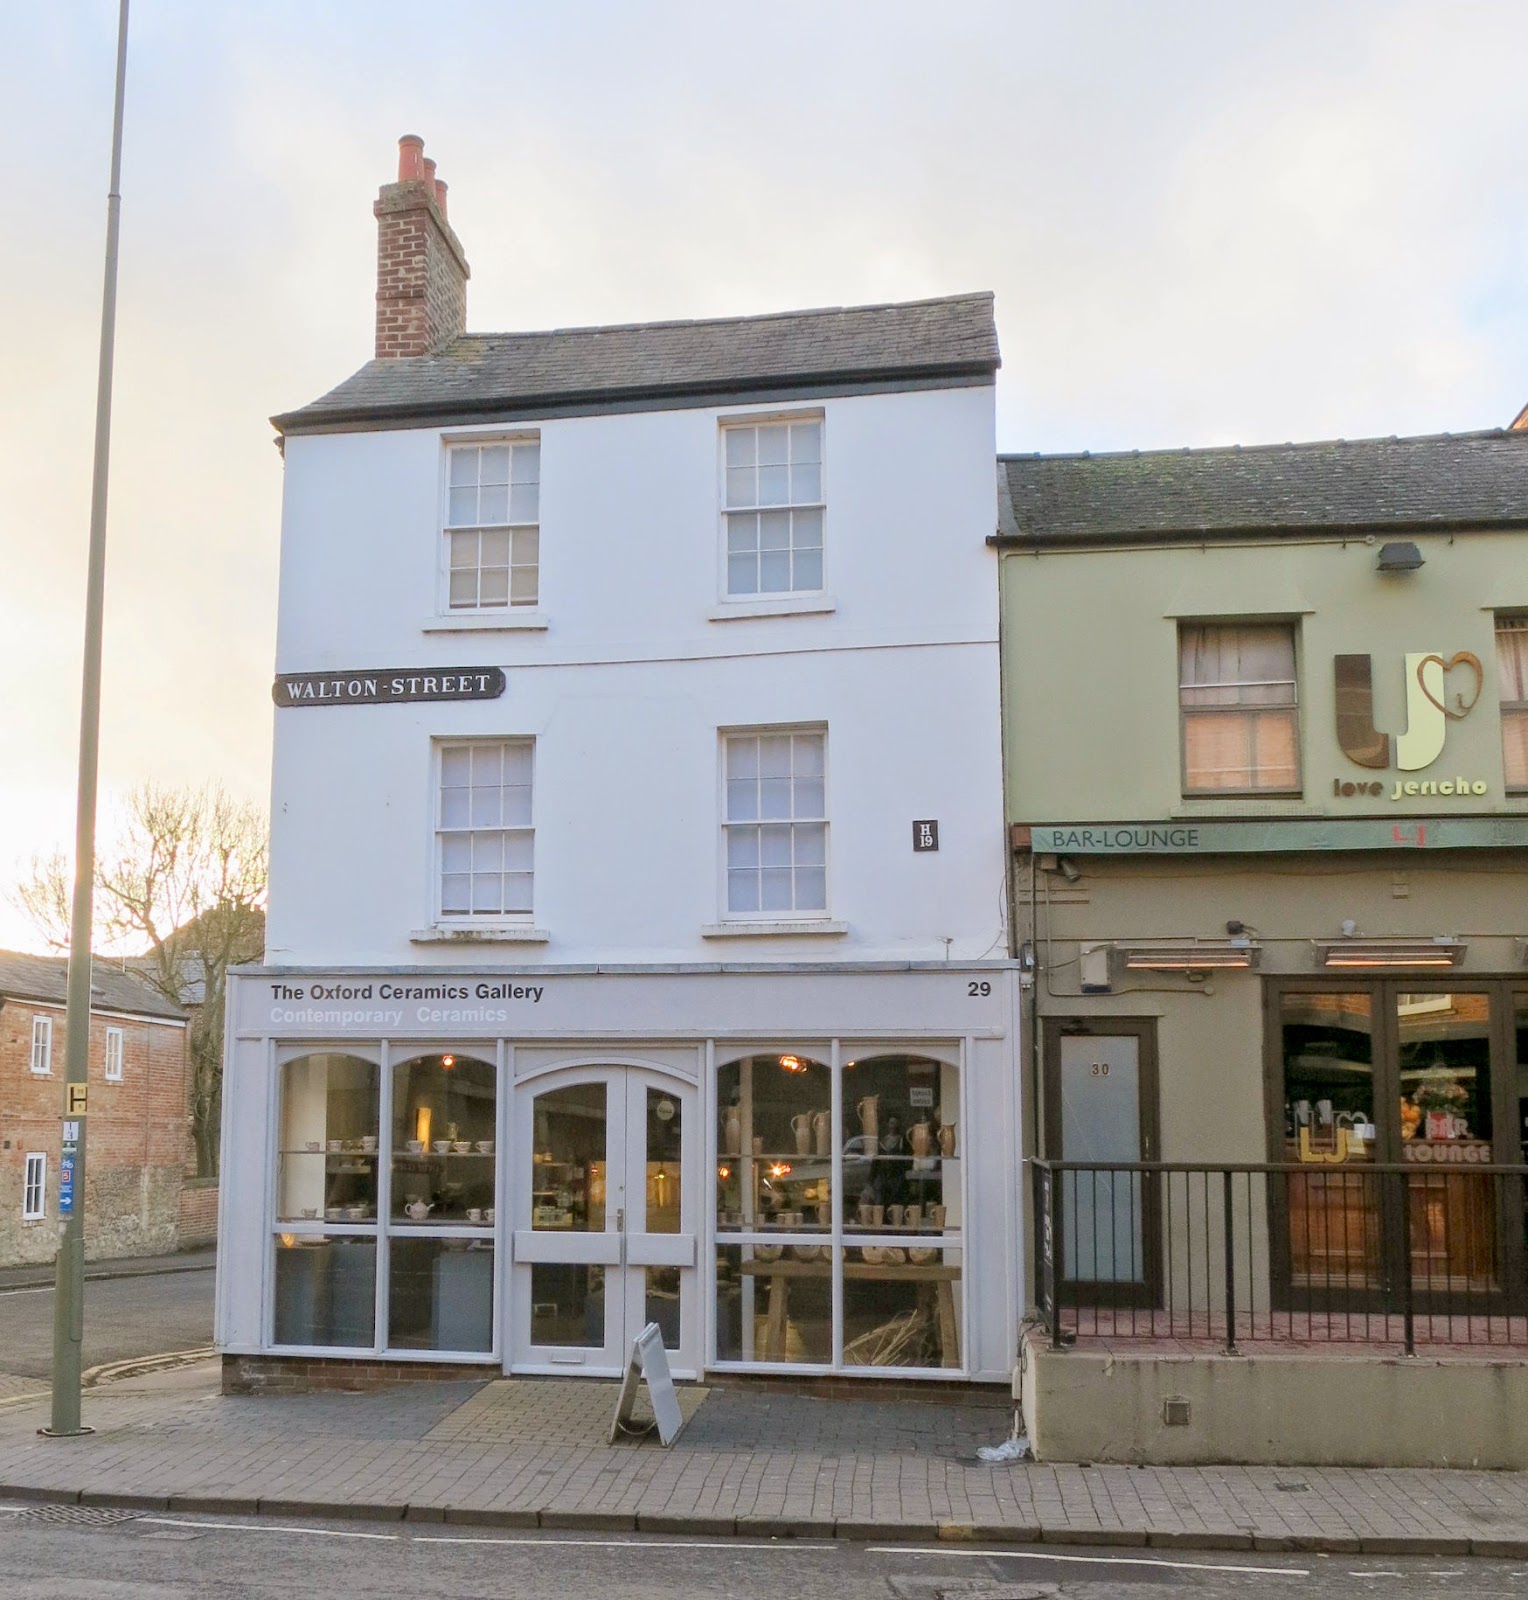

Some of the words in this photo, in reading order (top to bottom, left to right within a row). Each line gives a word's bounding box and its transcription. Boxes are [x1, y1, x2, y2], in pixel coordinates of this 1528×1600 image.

[1333, 778, 1384, 797] love
[1391, 776, 1487, 801] jericho
[920, 824, 930, 835] H
[1053, 829, 1199, 848] BAR-LOUNGE
[920, 835, 933, 847] 19
[271, 984, 304, 1000] The
[310, 984, 373, 1000] Oxford
[378, 983, 469, 1000] Ceramics
[475, 983, 545, 1003] Gallery
[968, 981, 991, 997] 29
[269, 1007, 403, 1026] Contemporary
[416, 1006, 508, 1023] Ceramics
[1092, 1063, 1109, 1075] 30
[70, 1086, 88, 1112] H
